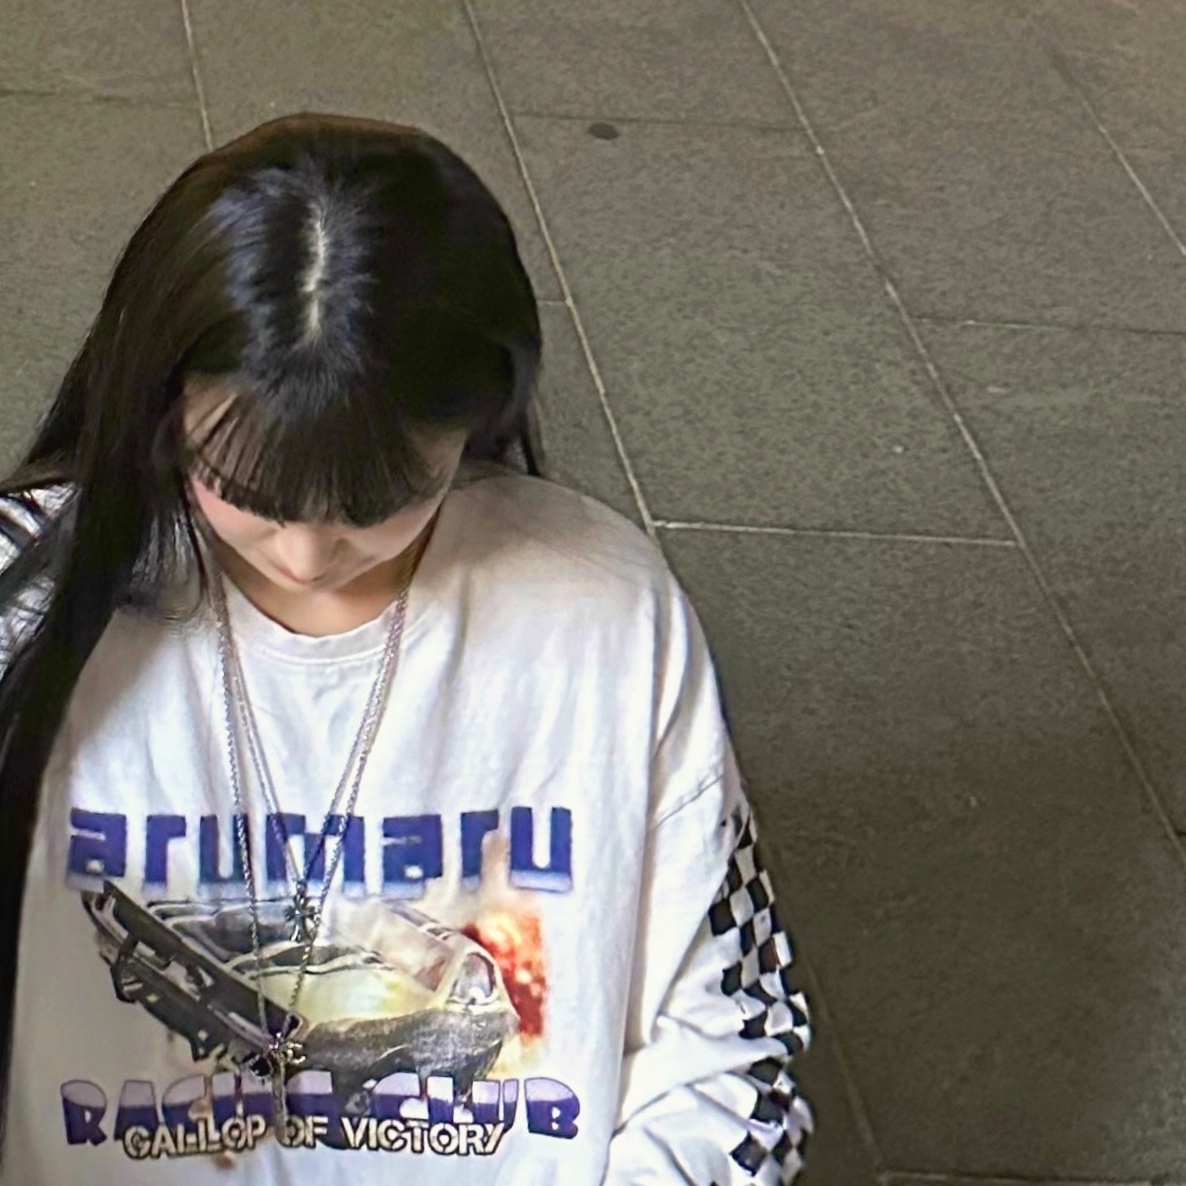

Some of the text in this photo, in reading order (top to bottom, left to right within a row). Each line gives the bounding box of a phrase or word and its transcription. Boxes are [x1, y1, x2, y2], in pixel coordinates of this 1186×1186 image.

[67, 804, 573, 893] arumaru
[123, 1113, 506, 1160] GALLOP OF VICTORY
[370, 1072, 581, 1139] CLUB
